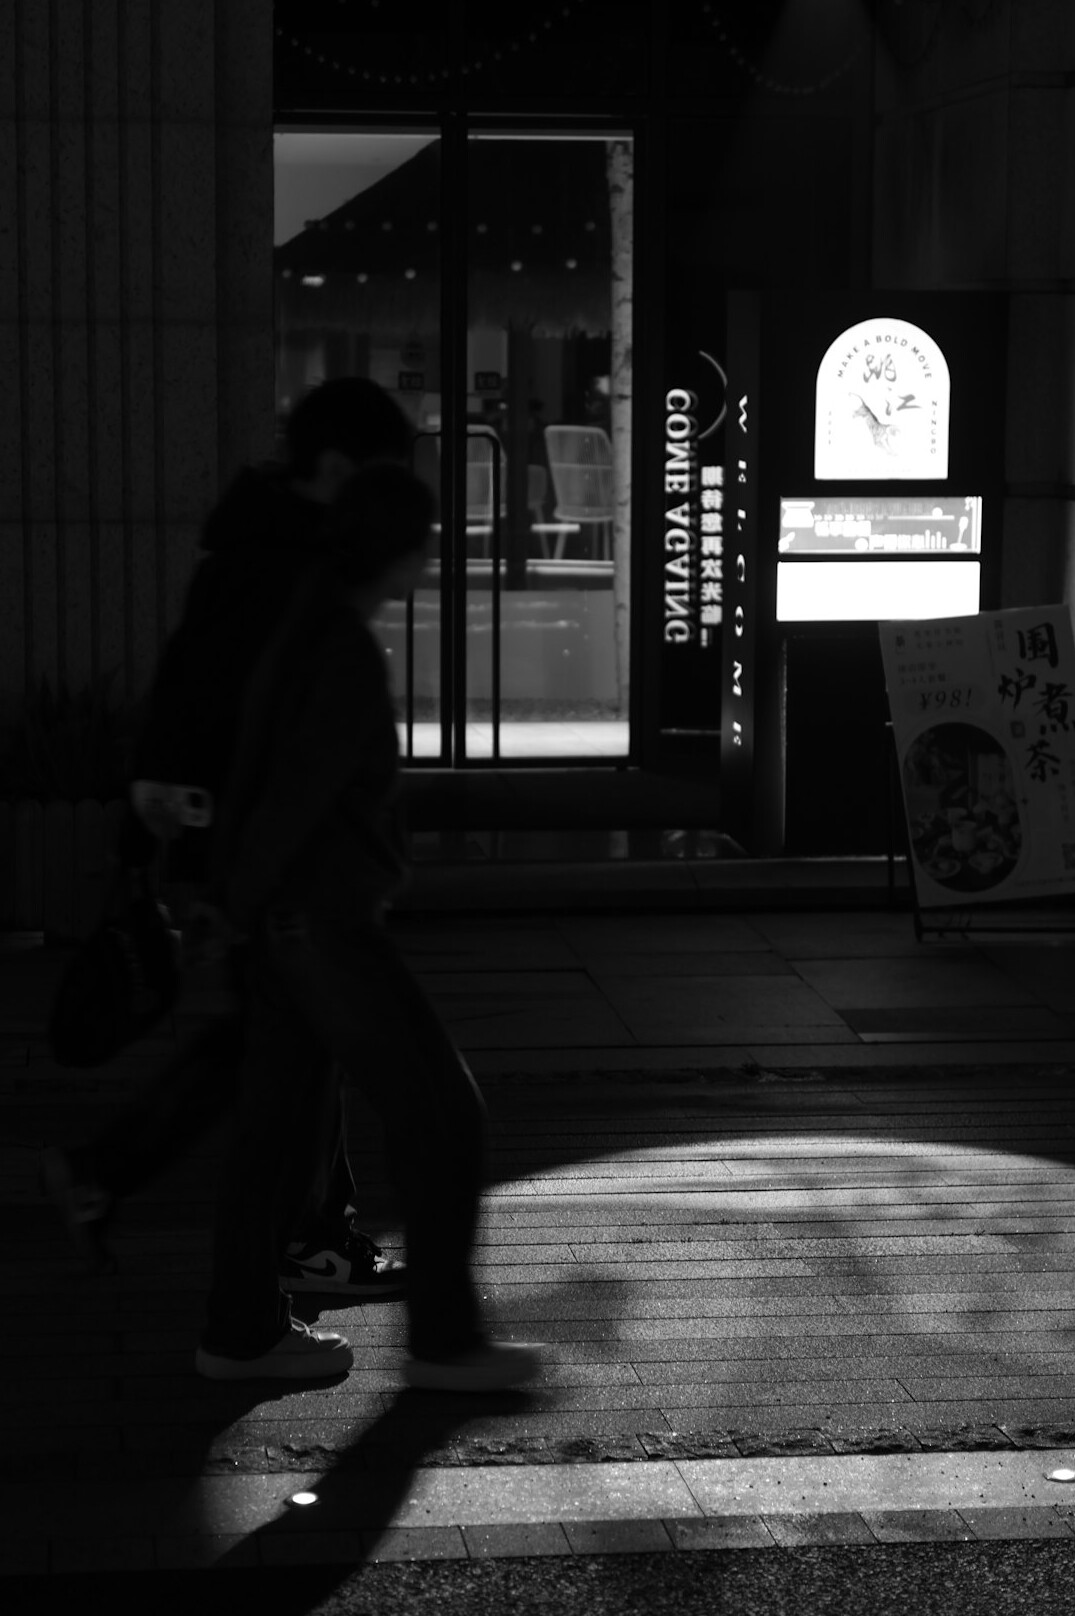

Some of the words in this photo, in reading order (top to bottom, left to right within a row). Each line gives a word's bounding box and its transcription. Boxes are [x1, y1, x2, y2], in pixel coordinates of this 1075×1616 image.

[837, 346, 859, 378] MAKE
[863, 339, 871, 347] A
[875, 335, 909, 348] BOLD
[910, 346, 933, 379] MOVE
